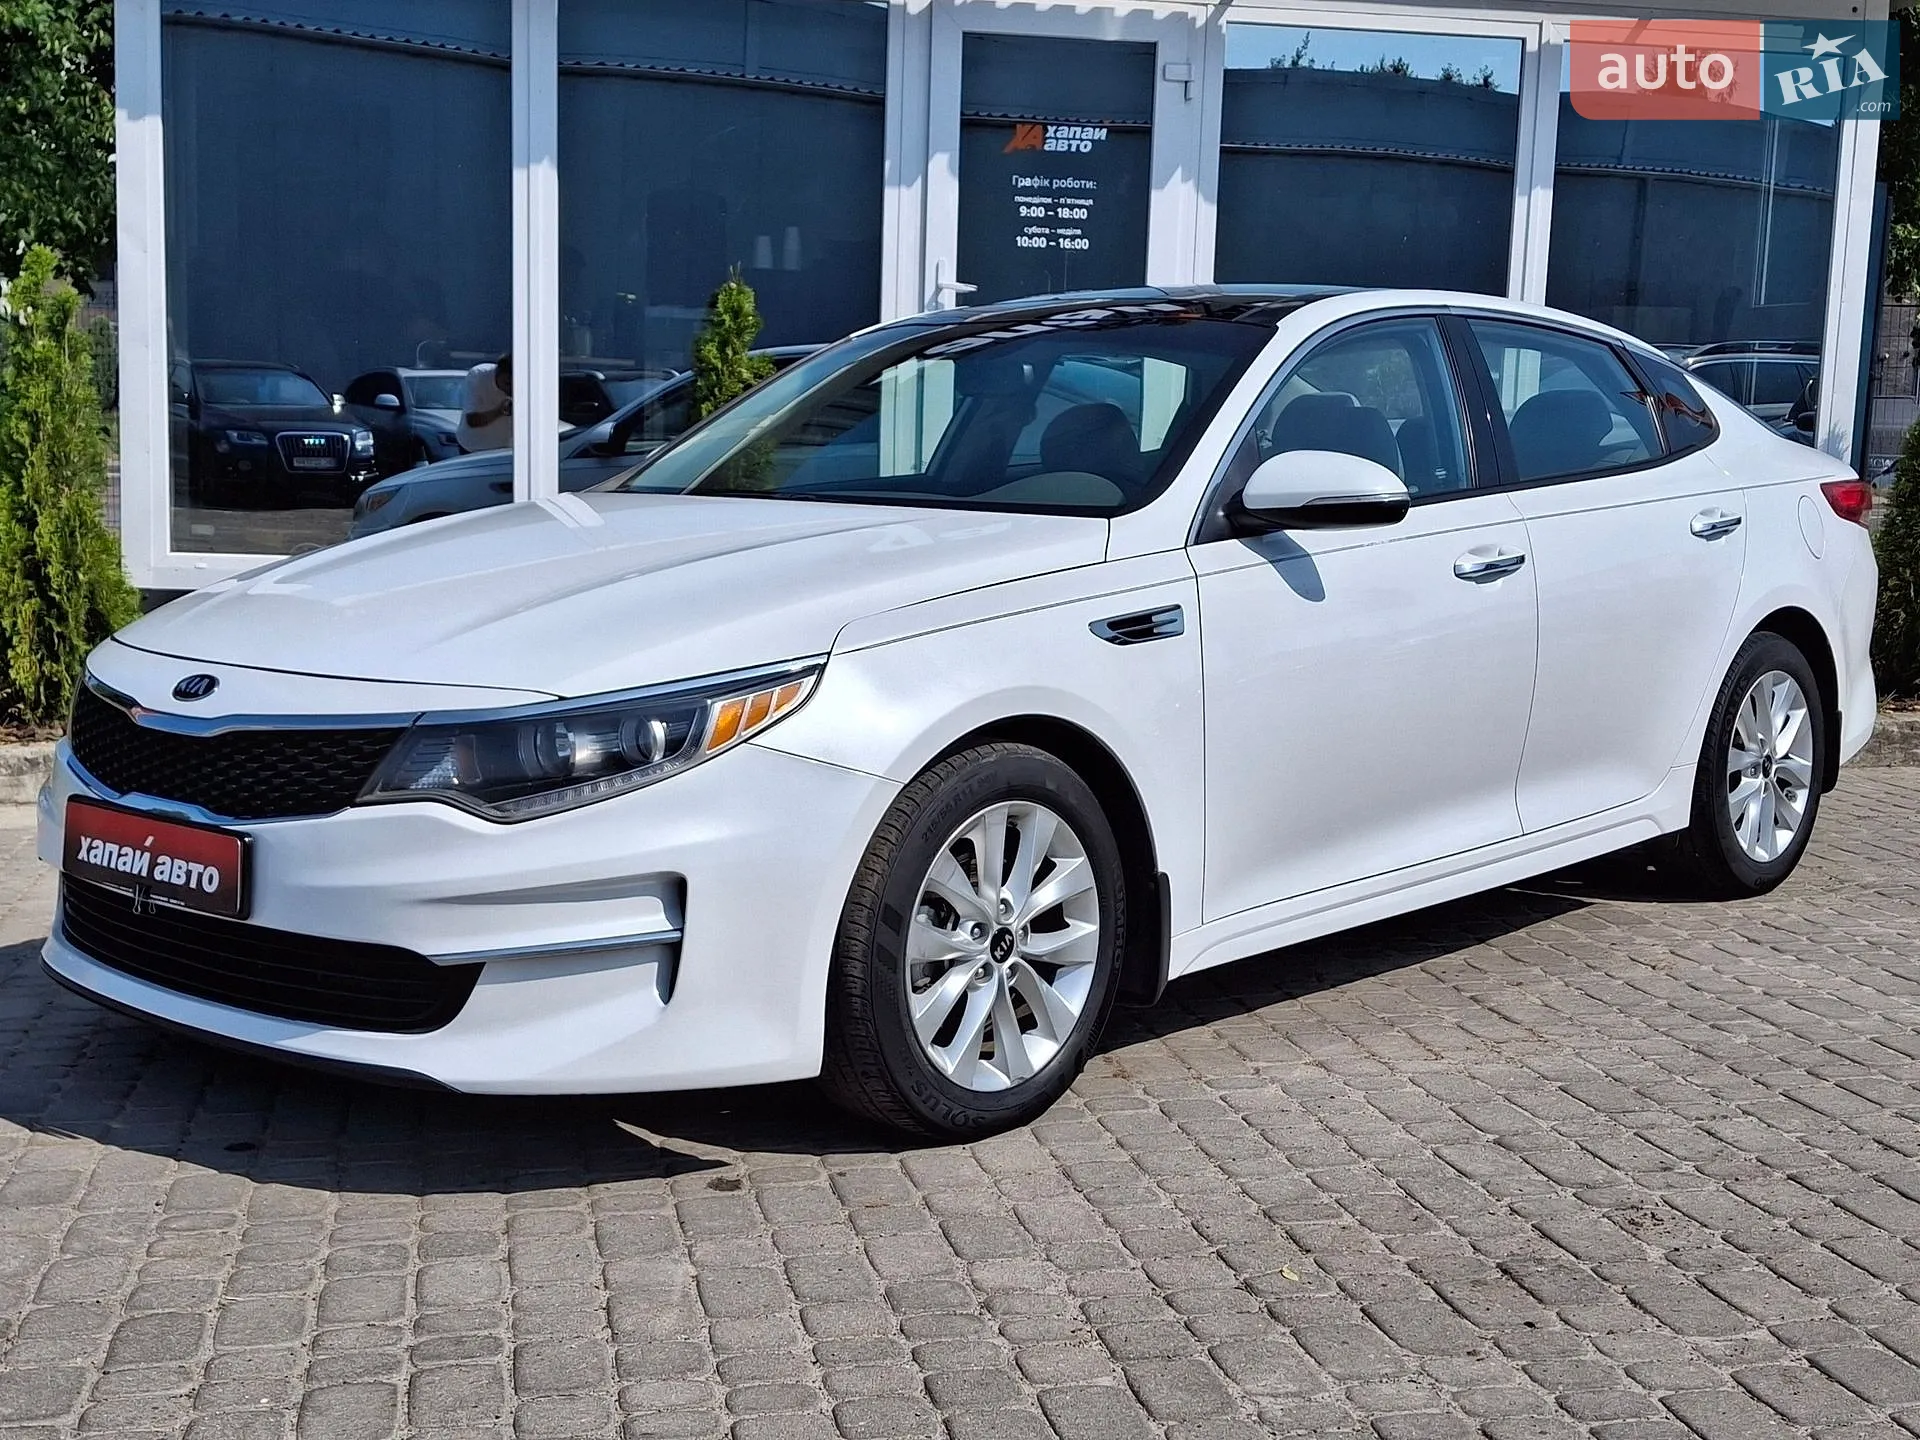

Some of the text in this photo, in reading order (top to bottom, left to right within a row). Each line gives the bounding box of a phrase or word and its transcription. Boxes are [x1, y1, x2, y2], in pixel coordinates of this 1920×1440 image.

[1043, 138, 1093, 153] авто
[1012, 175, 1097, 189] Графік роботи:
[1019, 205, 1046, 218] 9:00
[1056, 207, 1088, 220] 18:00
[1015, 235, 1048, 248] 10:00
[1058, 238, 1090, 250] 16:00
[153, 854, 220, 894] авто
[994, 934, 1013, 960] KIA
